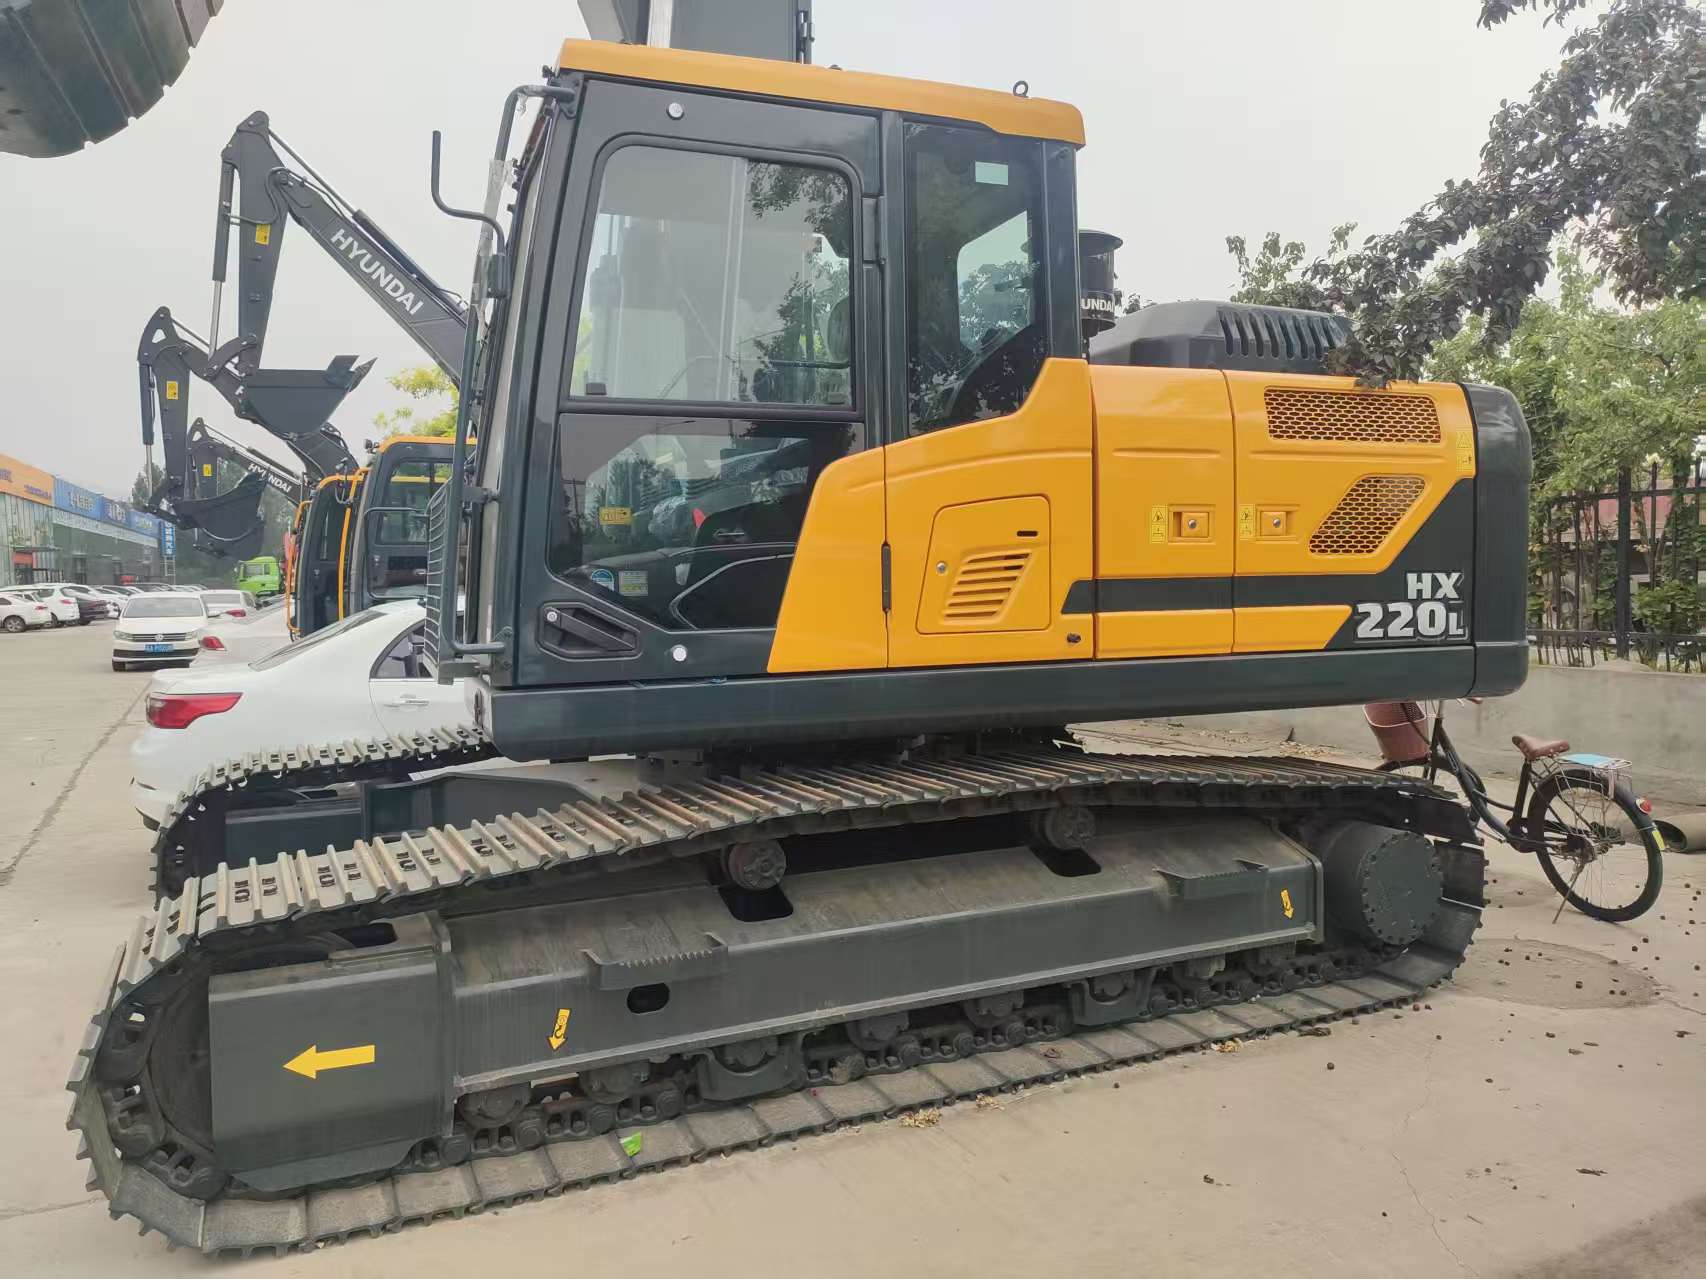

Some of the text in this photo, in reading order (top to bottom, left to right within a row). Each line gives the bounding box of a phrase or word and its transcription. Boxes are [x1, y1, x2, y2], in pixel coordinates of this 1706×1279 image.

[330, 228, 424, 315] HYUNDAI
[1406, 572, 1462, 599] HX
[1356, 601, 1465, 638] 220L
